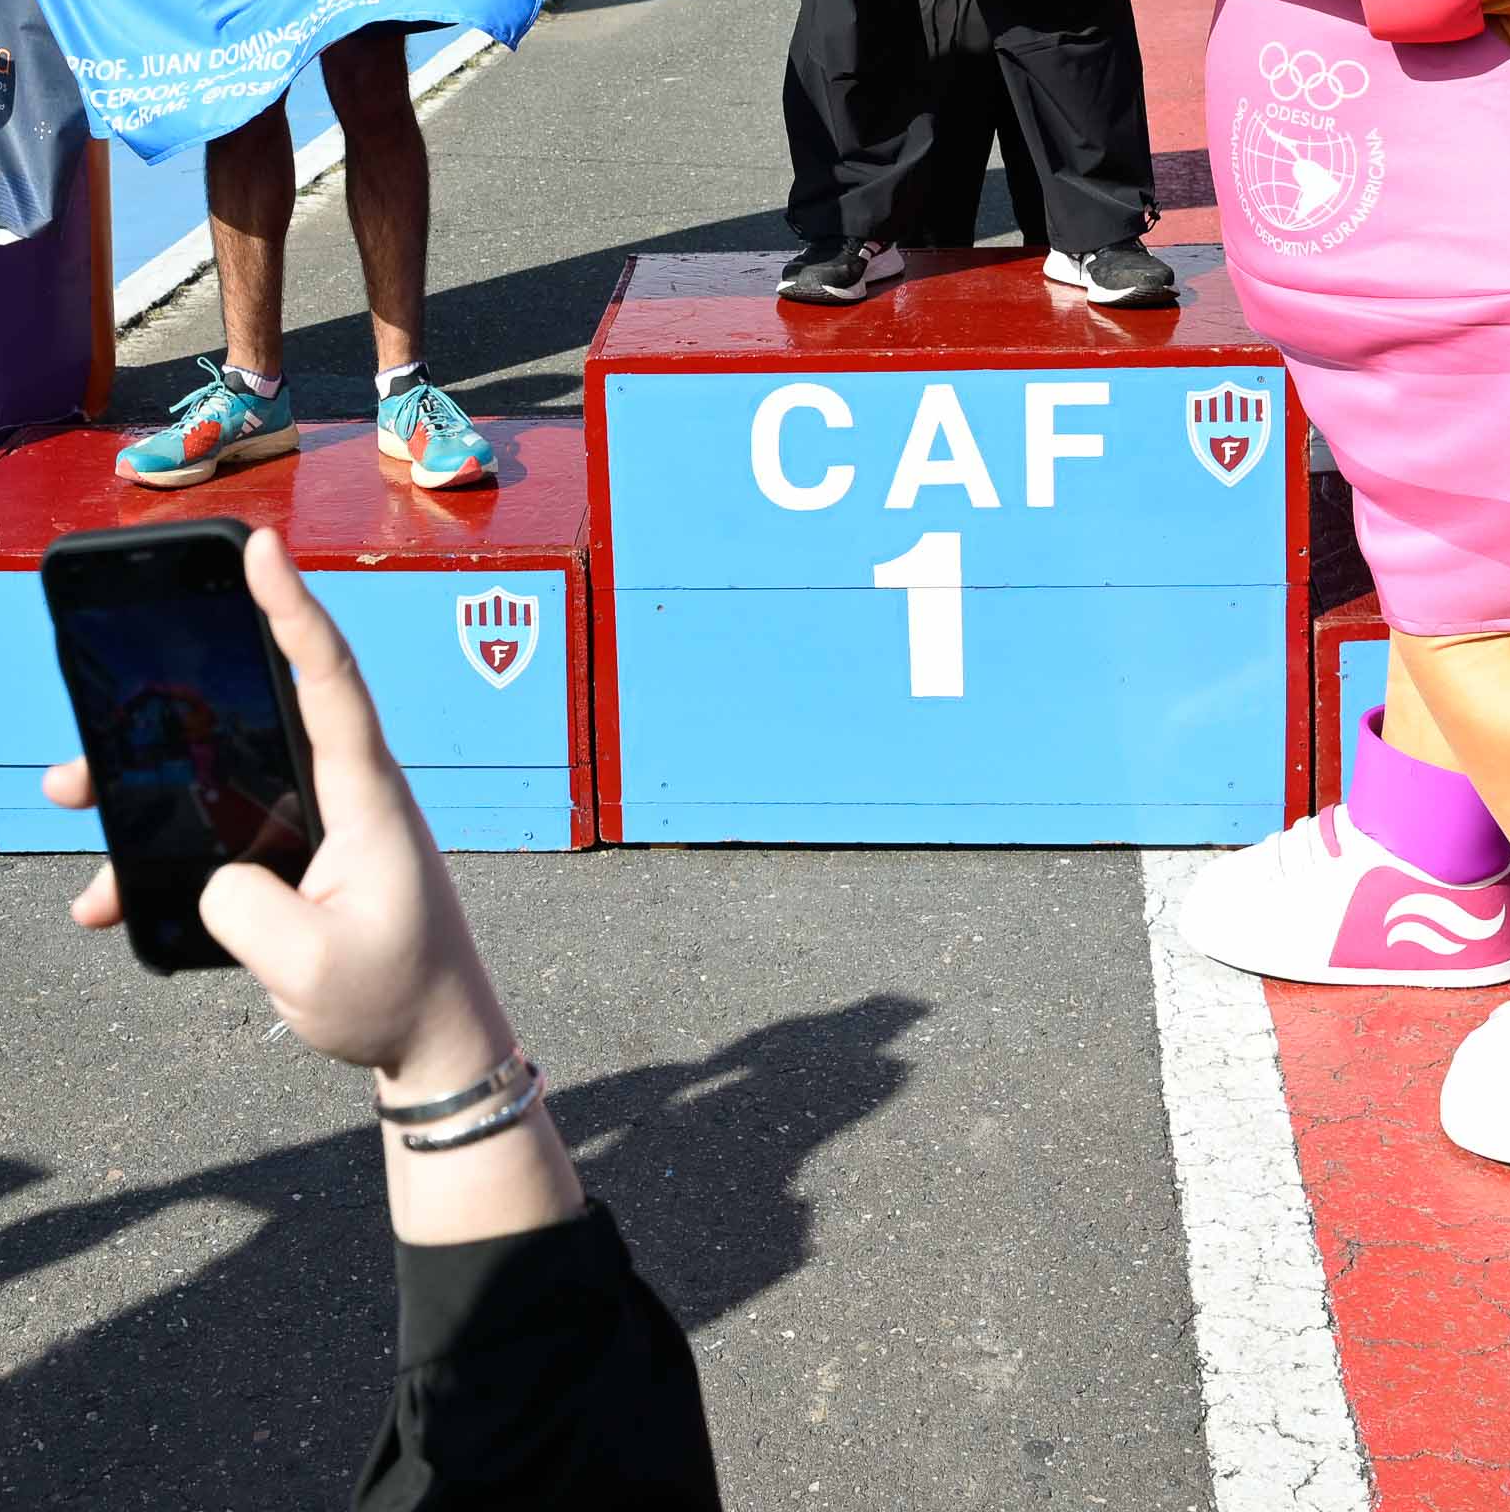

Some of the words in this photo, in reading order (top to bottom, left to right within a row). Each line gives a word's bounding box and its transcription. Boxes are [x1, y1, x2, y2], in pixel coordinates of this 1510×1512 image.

[65, 55, 134, 81] PROF.
[139, 51, 203, 81] JUAN
[1266, 103, 1336, 133] ODESUR
[1254, 223, 1323, 257] DEPORTIVA
[1322, 127, 1386, 249] SURAMERICANA
[749, 380, 1113, 512] CAF
[872, 531, 965, 698] 1
